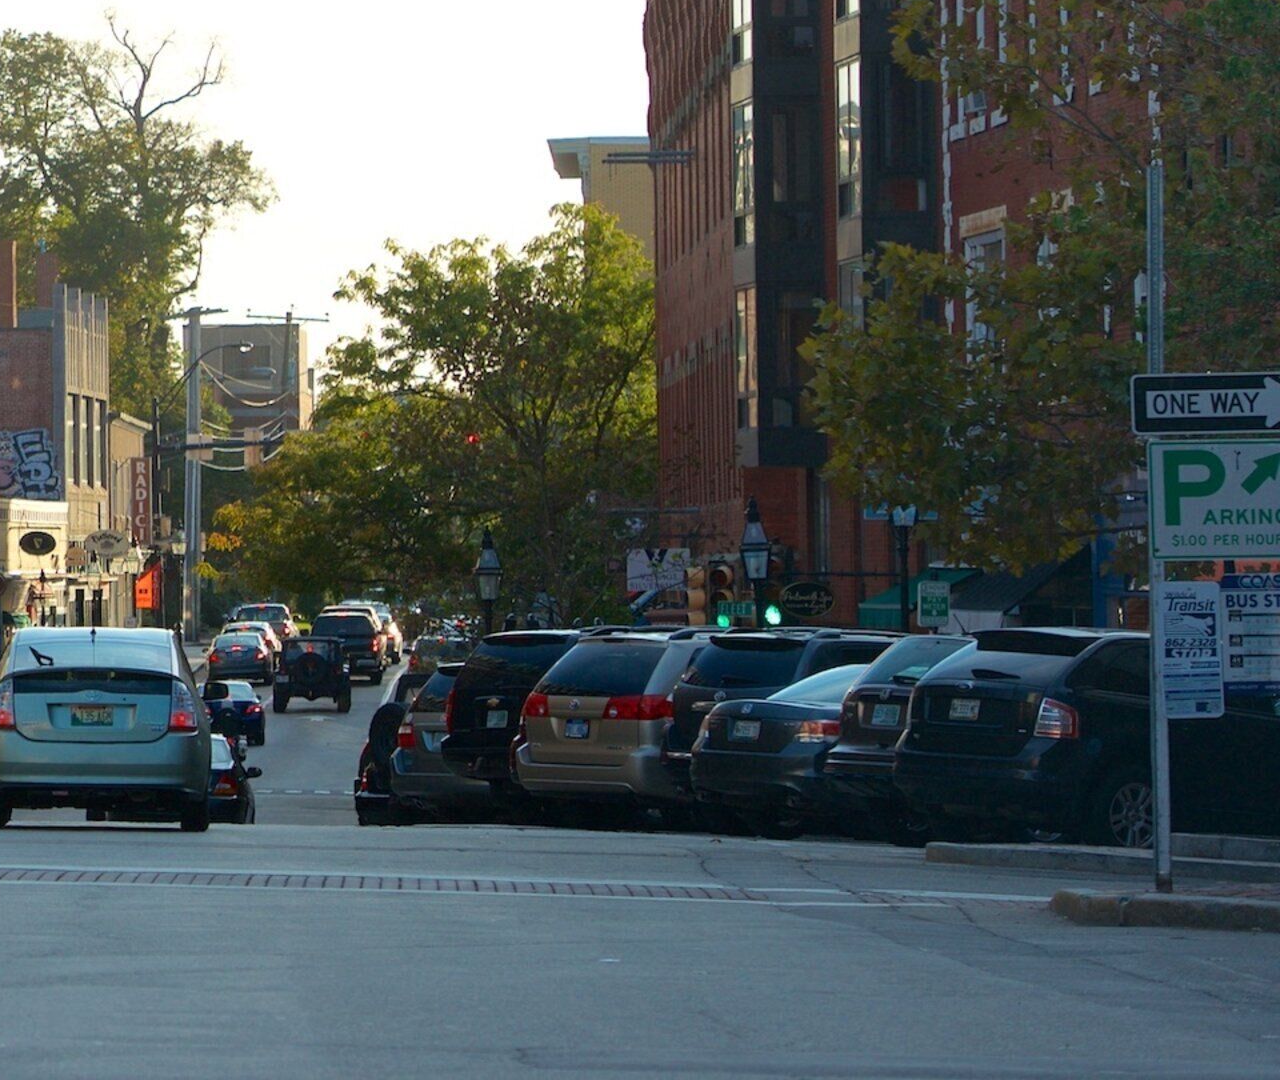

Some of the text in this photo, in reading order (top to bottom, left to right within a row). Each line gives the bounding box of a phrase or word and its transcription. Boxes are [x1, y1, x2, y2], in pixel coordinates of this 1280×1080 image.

[1153, 391, 1260, 414] ONE WAY
[135, 461, 147, 541] RADICI
[1171, 534, 1207, 547] $1.00
[1213, 534, 1239, 545] PER
[1168, 598, 1216, 611] Transit
[1226, 594, 1258, 608] BUS
[1165, 638, 1216, 647] 862-2328
